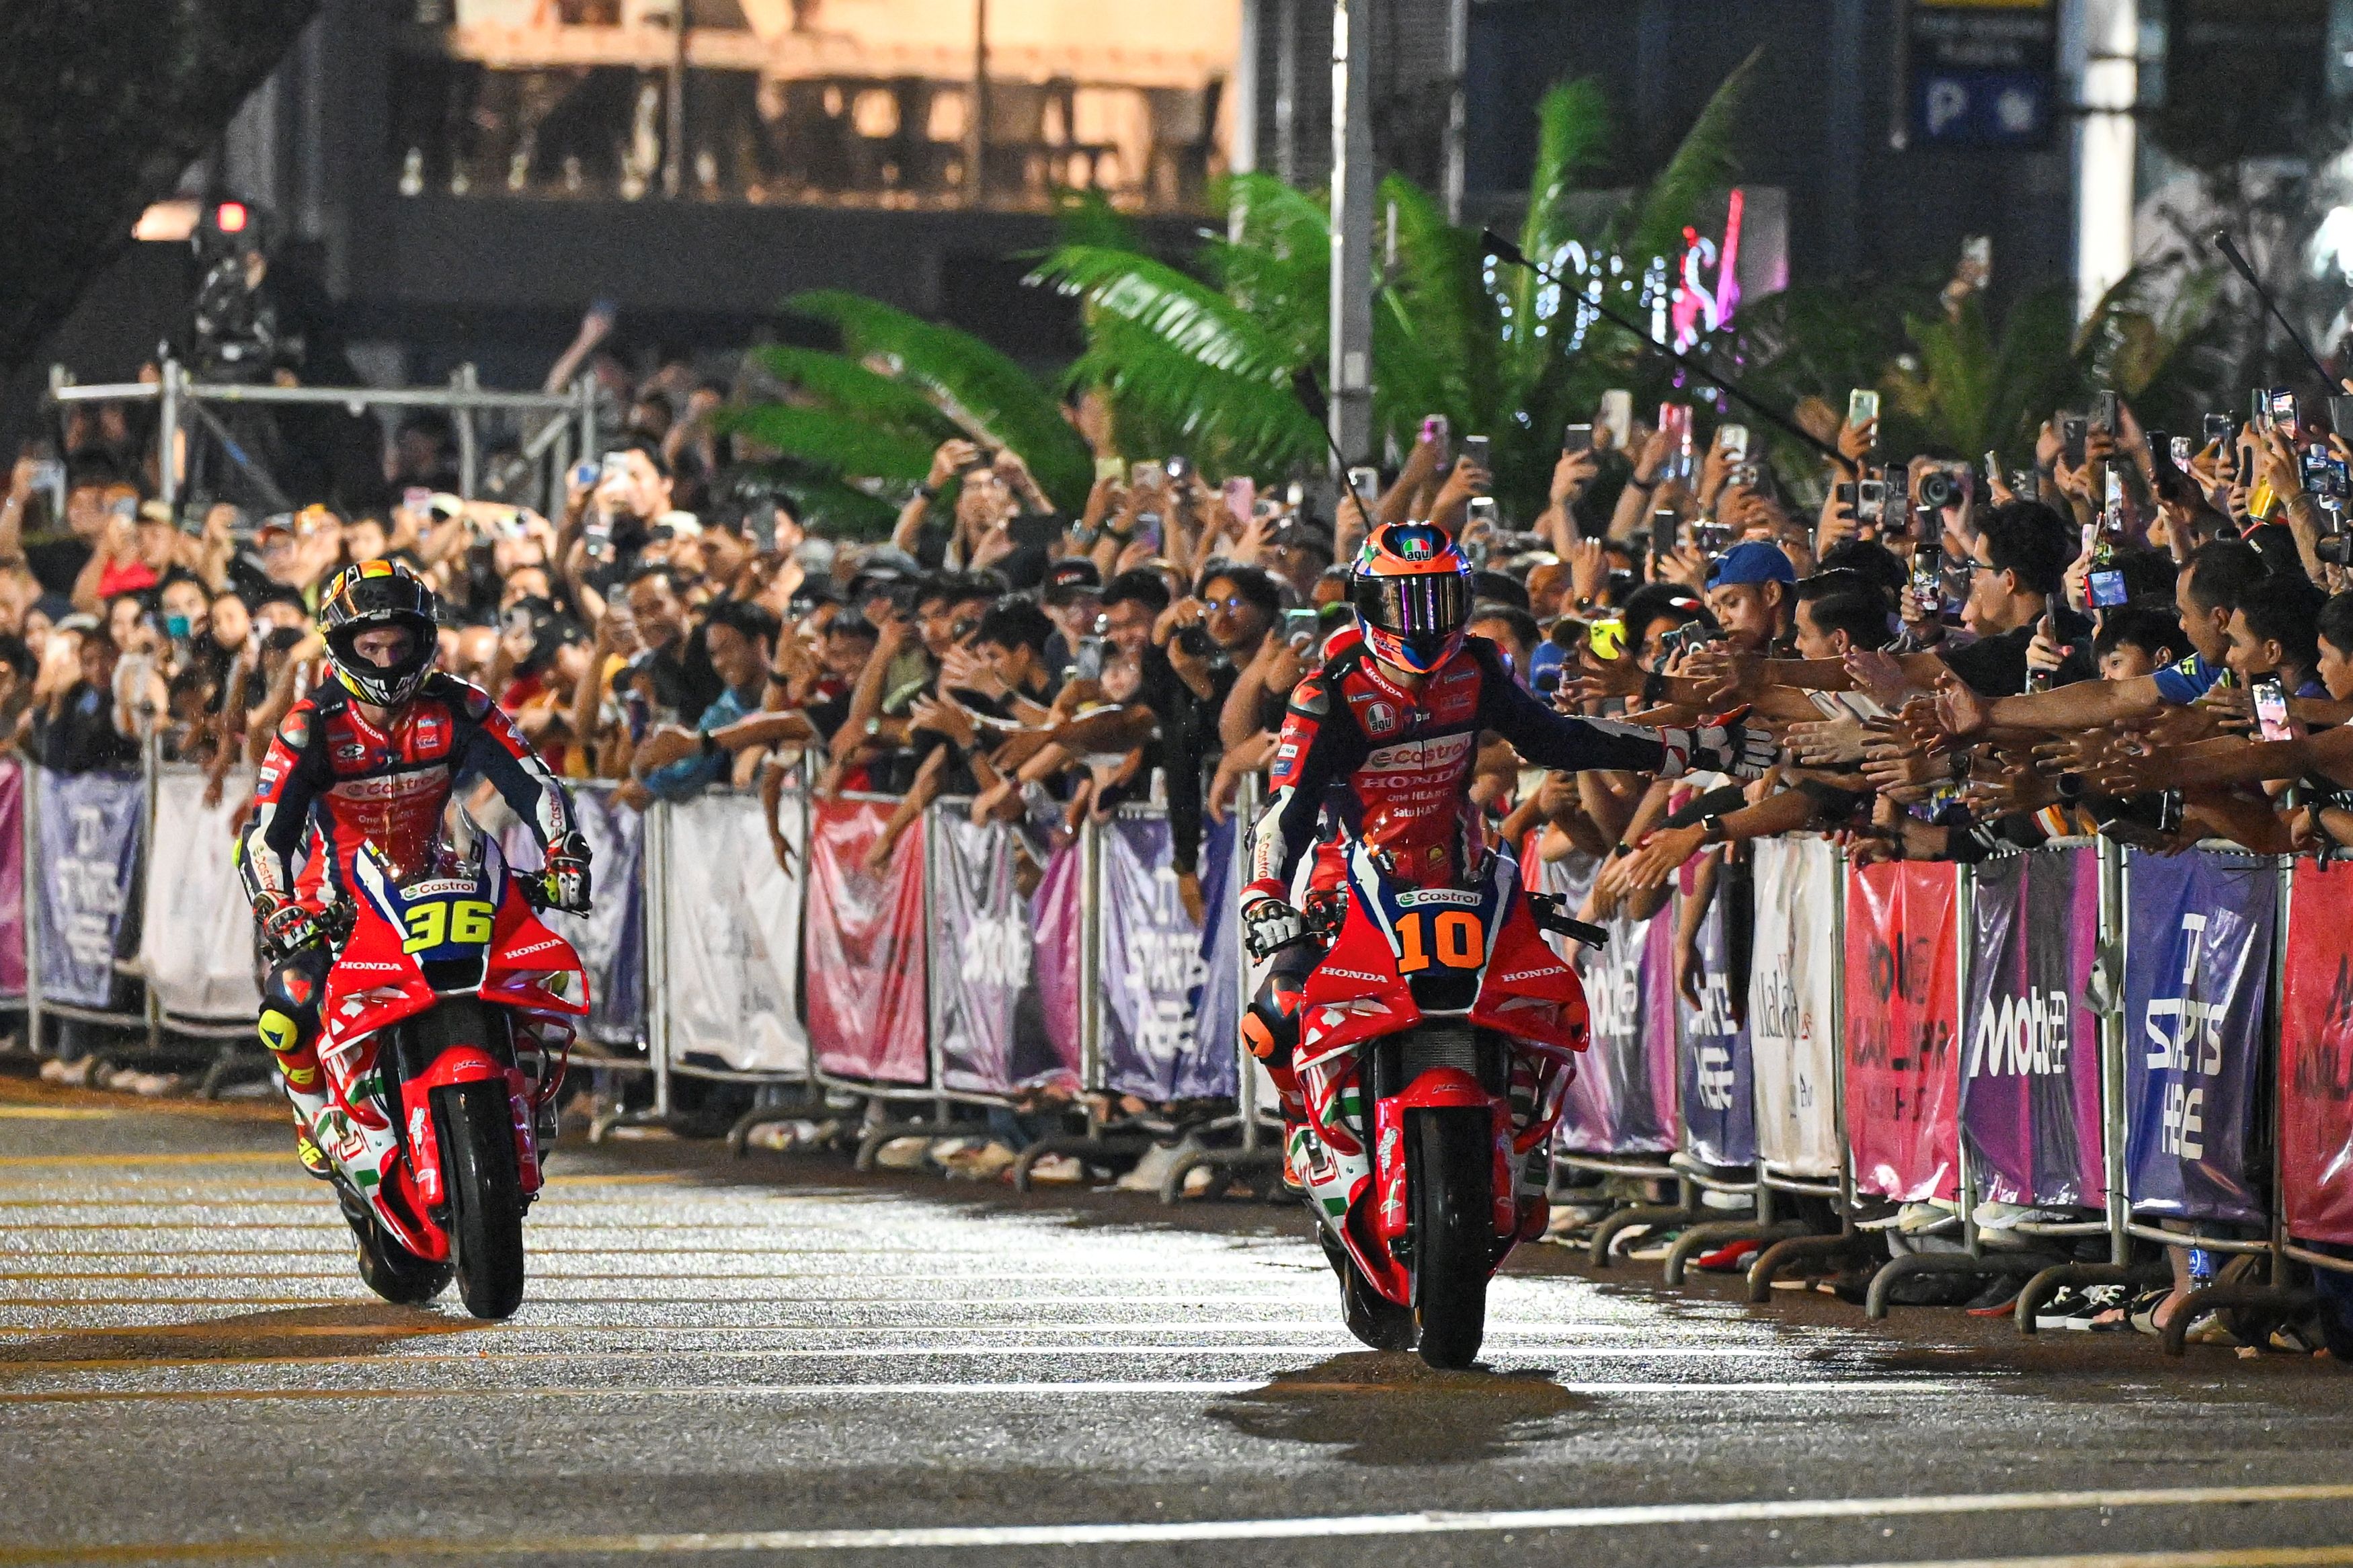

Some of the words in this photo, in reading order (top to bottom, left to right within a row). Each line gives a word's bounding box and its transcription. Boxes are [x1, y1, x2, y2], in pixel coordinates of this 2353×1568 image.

[1365, 666, 1404, 698] HONDA
[350, 709, 385, 741] HONDA
[1394, 737, 1469, 764] Castrol
[254, 855, 276, 891] Castro
[1258, 843, 1269, 878] Castro
[420, 882, 475, 893] Castrol
[1417, 892, 1478, 903] Castrol
[403, 900, 493, 954] 36
[504, 938, 564, 960] HONDA
[1395, 910, 1484, 973] 10
[339, 960, 403, 971] HONDA
[1319, 966, 1388, 983] HONDA
[1501, 965, 1568, 983] HONDA
